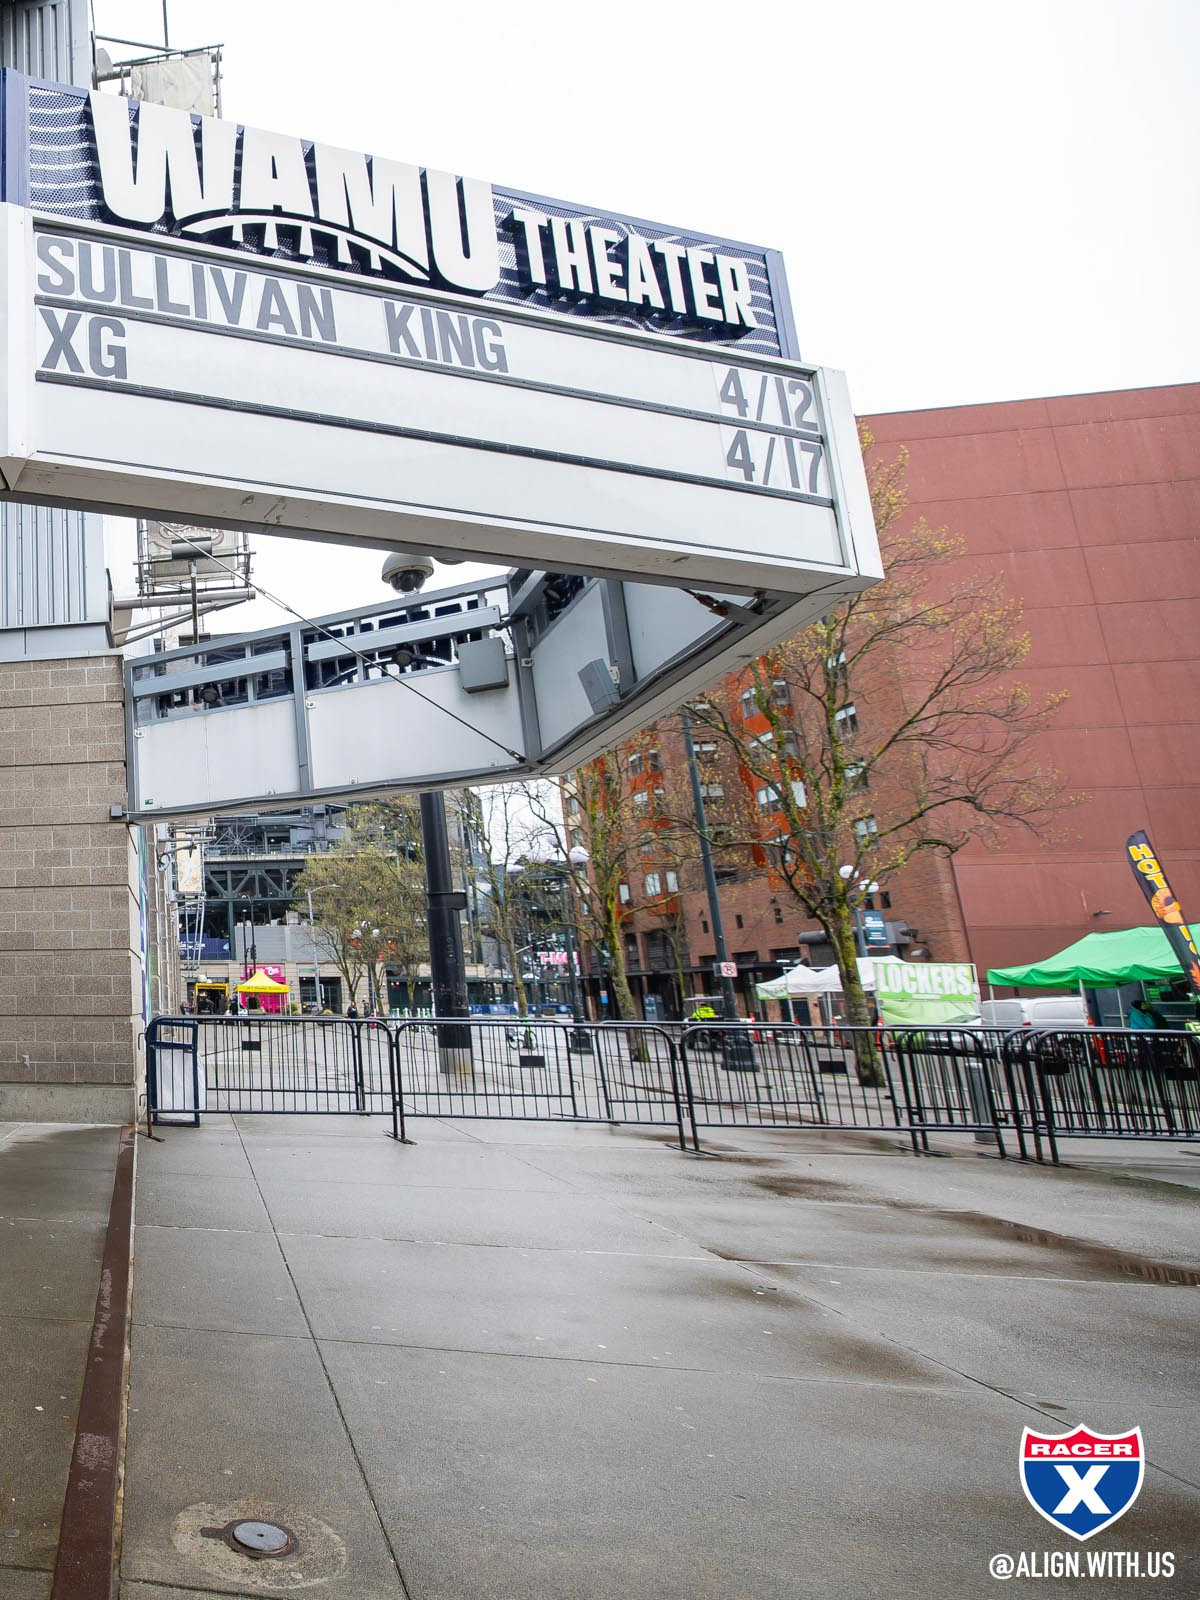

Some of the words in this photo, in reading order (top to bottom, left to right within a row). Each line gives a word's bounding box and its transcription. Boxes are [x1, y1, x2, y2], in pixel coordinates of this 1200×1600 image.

[87, 89, 500, 292] WAMU
[510, 206, 757, 330] THEATER
[36, 233, 339, 344] SULLIVAN
[384, 298, 508, 374] KING
[720, 366, 819, 433] 4/12
[37, 308, 129, 381] XG
[726, 429, 824, 495] 4/17
[1128, 843, 1168, 889] HOT
[877, 963, 972, 996] LOCKERS
